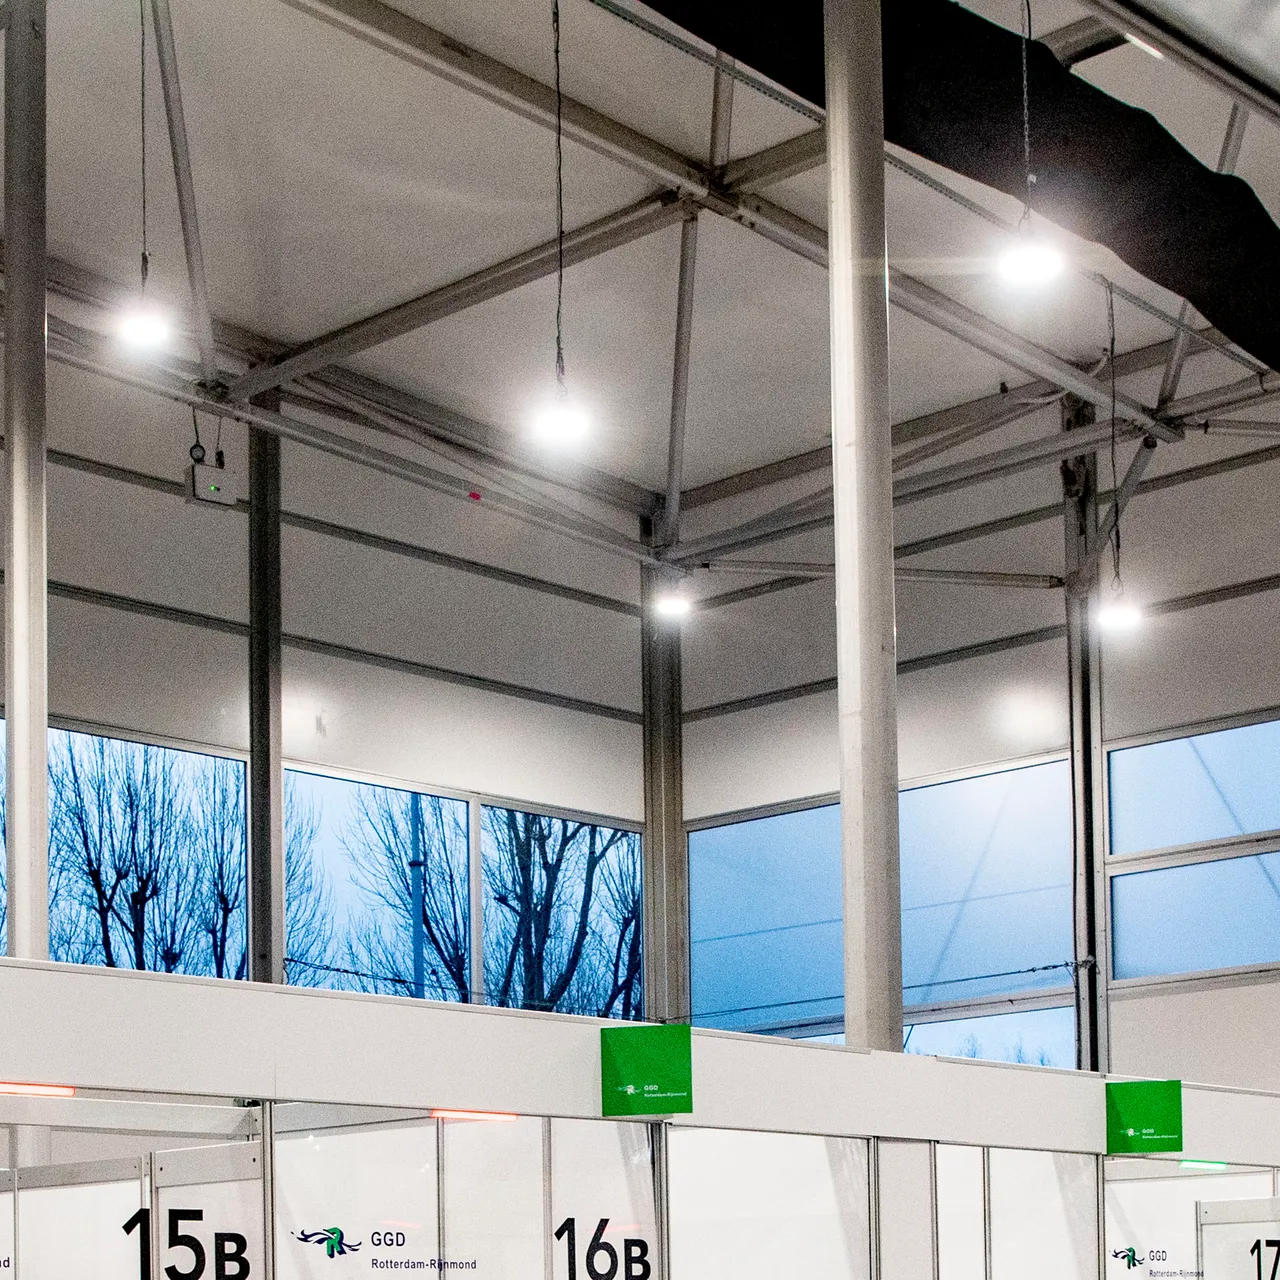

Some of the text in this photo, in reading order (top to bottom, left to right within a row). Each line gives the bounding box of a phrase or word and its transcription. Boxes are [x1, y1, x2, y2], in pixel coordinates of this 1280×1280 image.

[371, 1231, 406, 1247] GGD
[1149, 1250, 1168, 1261] GGD
[371, 1258, 477, 1272] Rotterdam-Rijnmond
